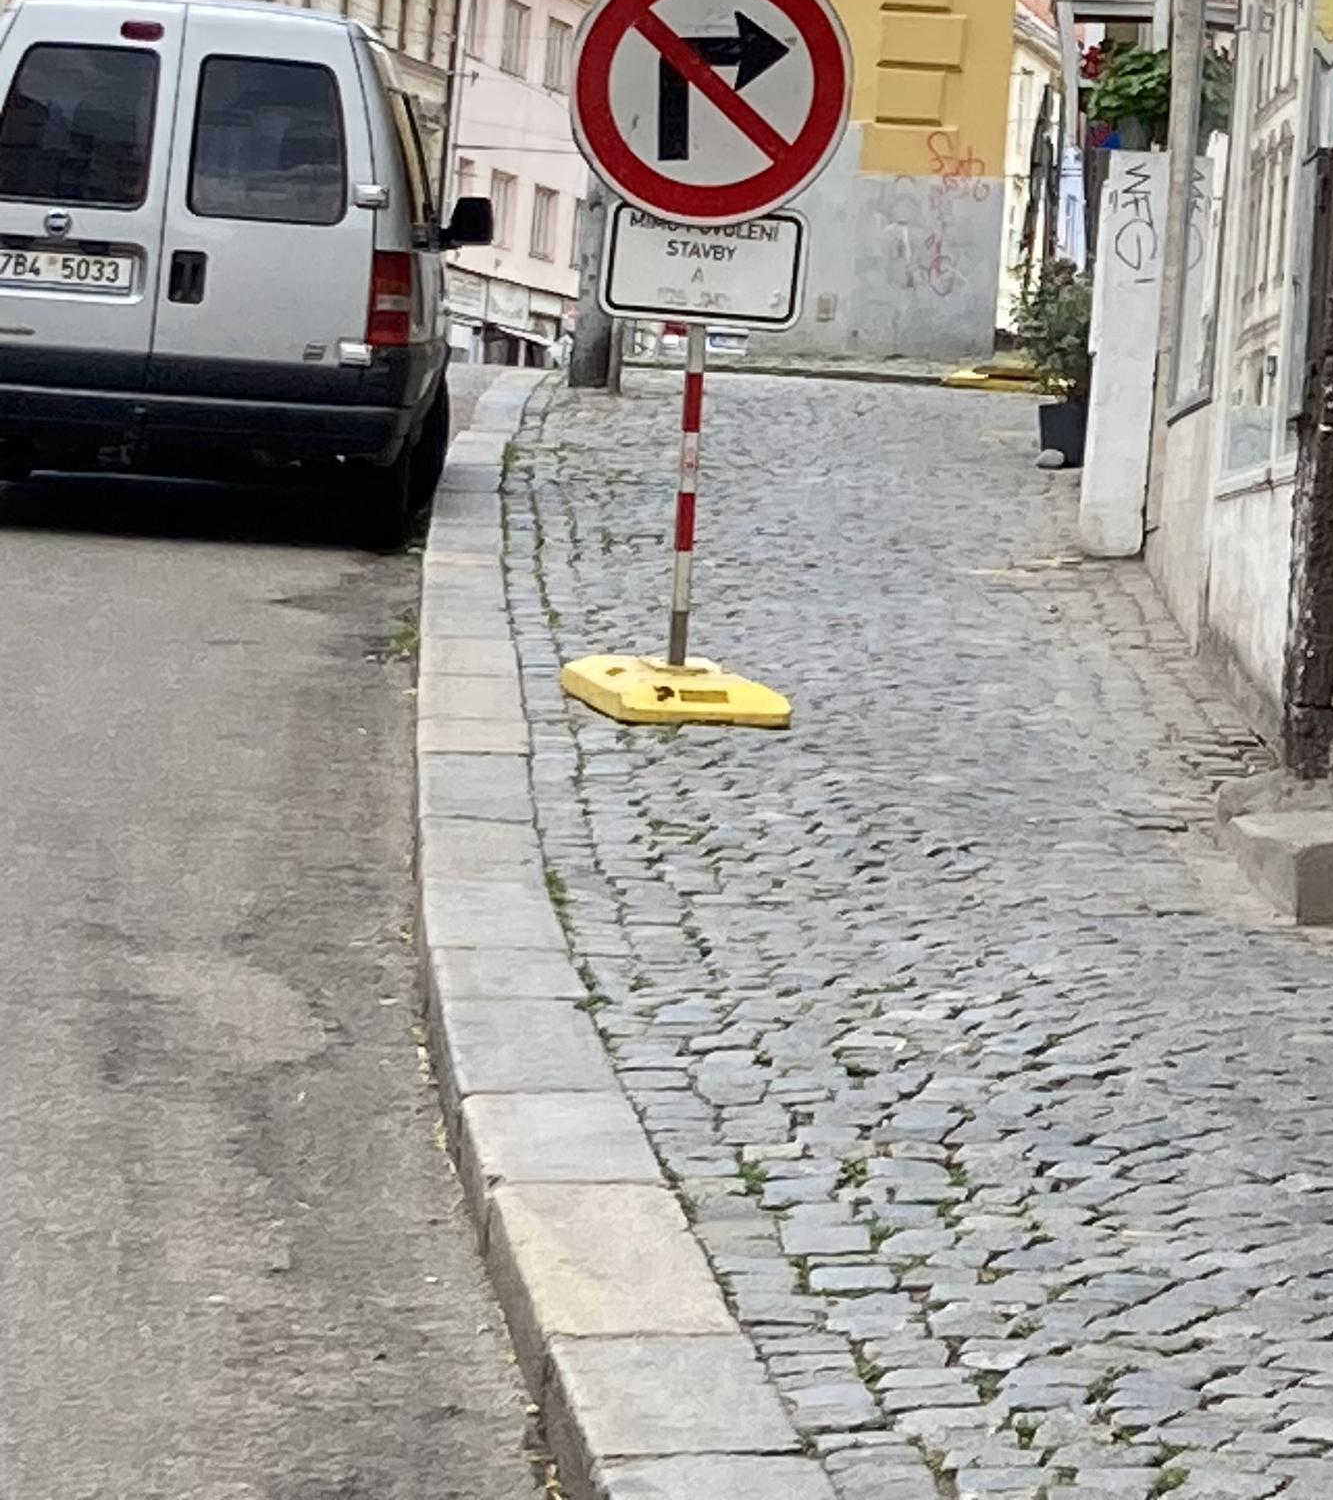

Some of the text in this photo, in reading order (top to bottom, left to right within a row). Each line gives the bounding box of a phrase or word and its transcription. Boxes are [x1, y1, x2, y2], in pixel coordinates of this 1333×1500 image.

[665, 239, 737, 261] STAVBY
[0, 253, 119, 284] 7B4 5033
[690, 266, 704, 284] A
